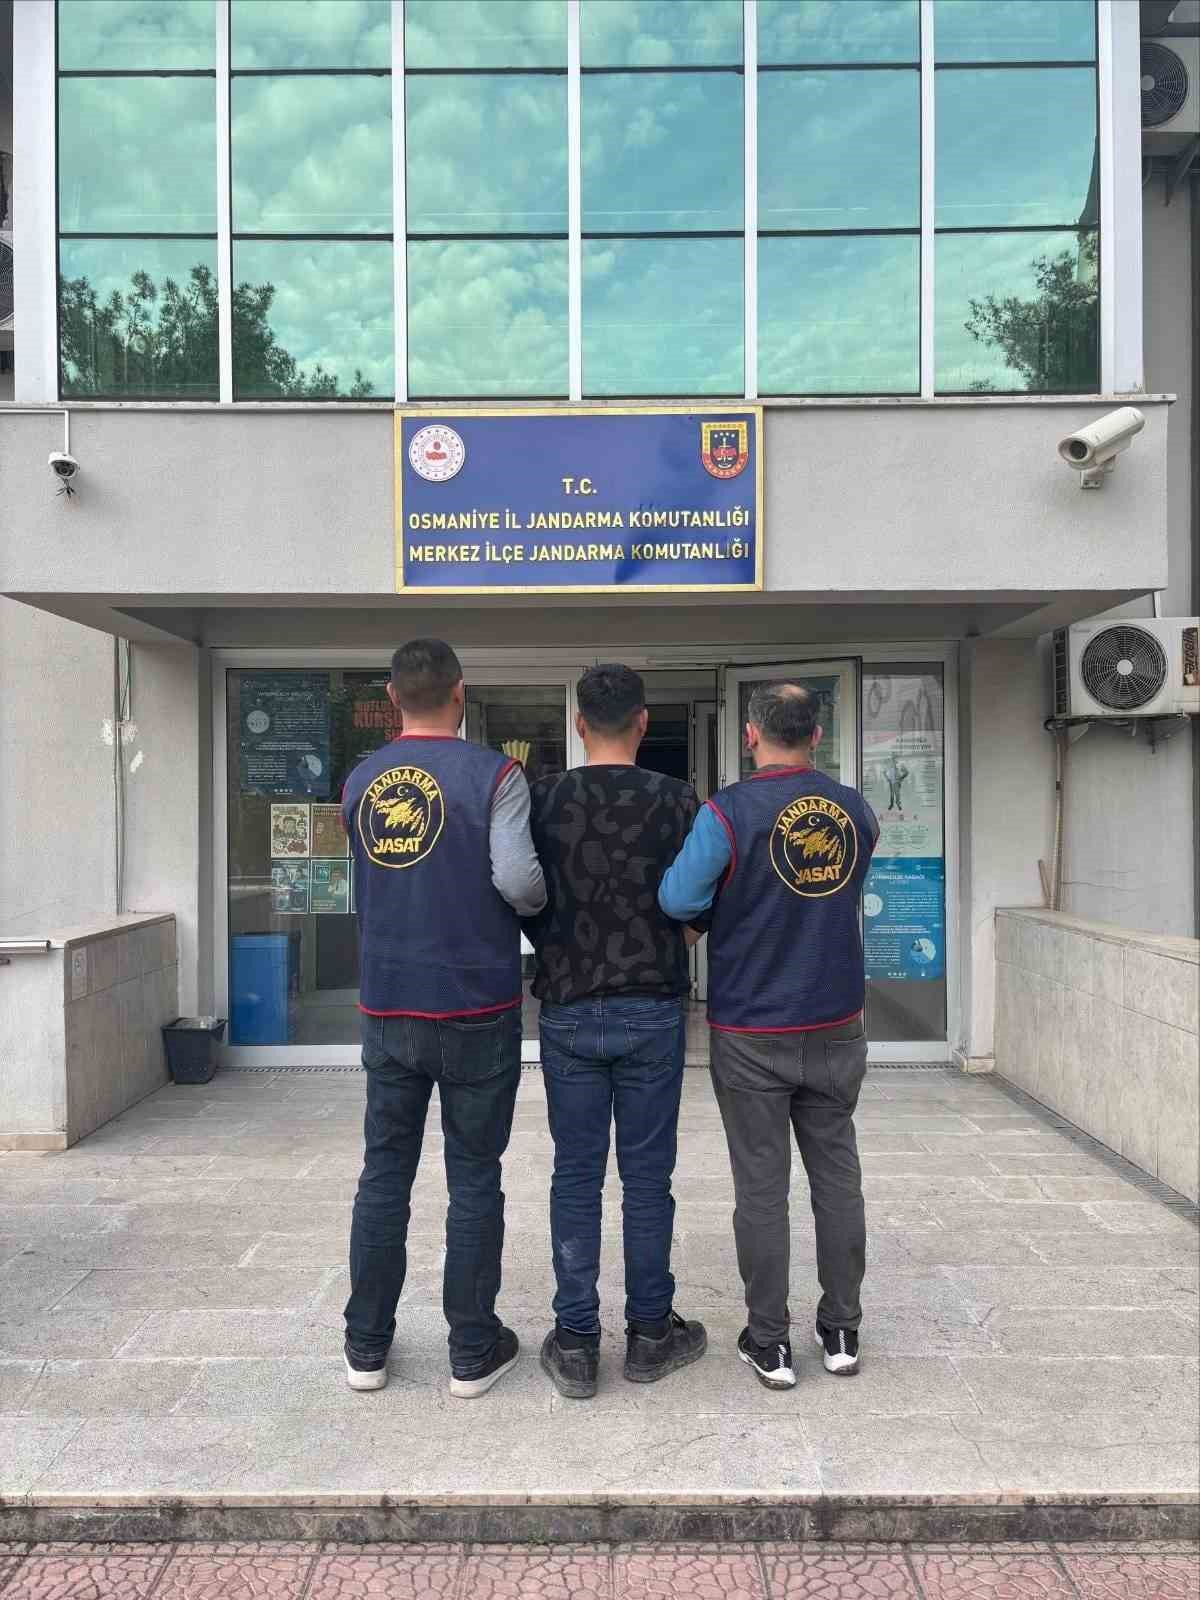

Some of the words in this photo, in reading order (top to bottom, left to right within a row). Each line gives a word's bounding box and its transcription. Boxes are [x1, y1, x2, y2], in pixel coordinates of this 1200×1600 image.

[562, 477, 598, 494] T.C.
[409, 508, 500, 529] OSMANİYE
[505, 508, 522, 529] İL
[526, 511, 624, 529] JANDARMA
[629, 505, 749, 528] KOMUTANLIĞI
[408, 545, 481, 562] MERKEZ
[485, 540, 524, 563] İLÇE
[528, 543, 625, 561] JANDARMA
[631, 537, 749, 560] KOMUTANLIĞI
[367, 769, 438, 803] JANDARMA
[777, 799, 849, 835] JANDARMA
[373, 836, 423, 854] JASAT
[795, 864, 843, 885] JASAT
